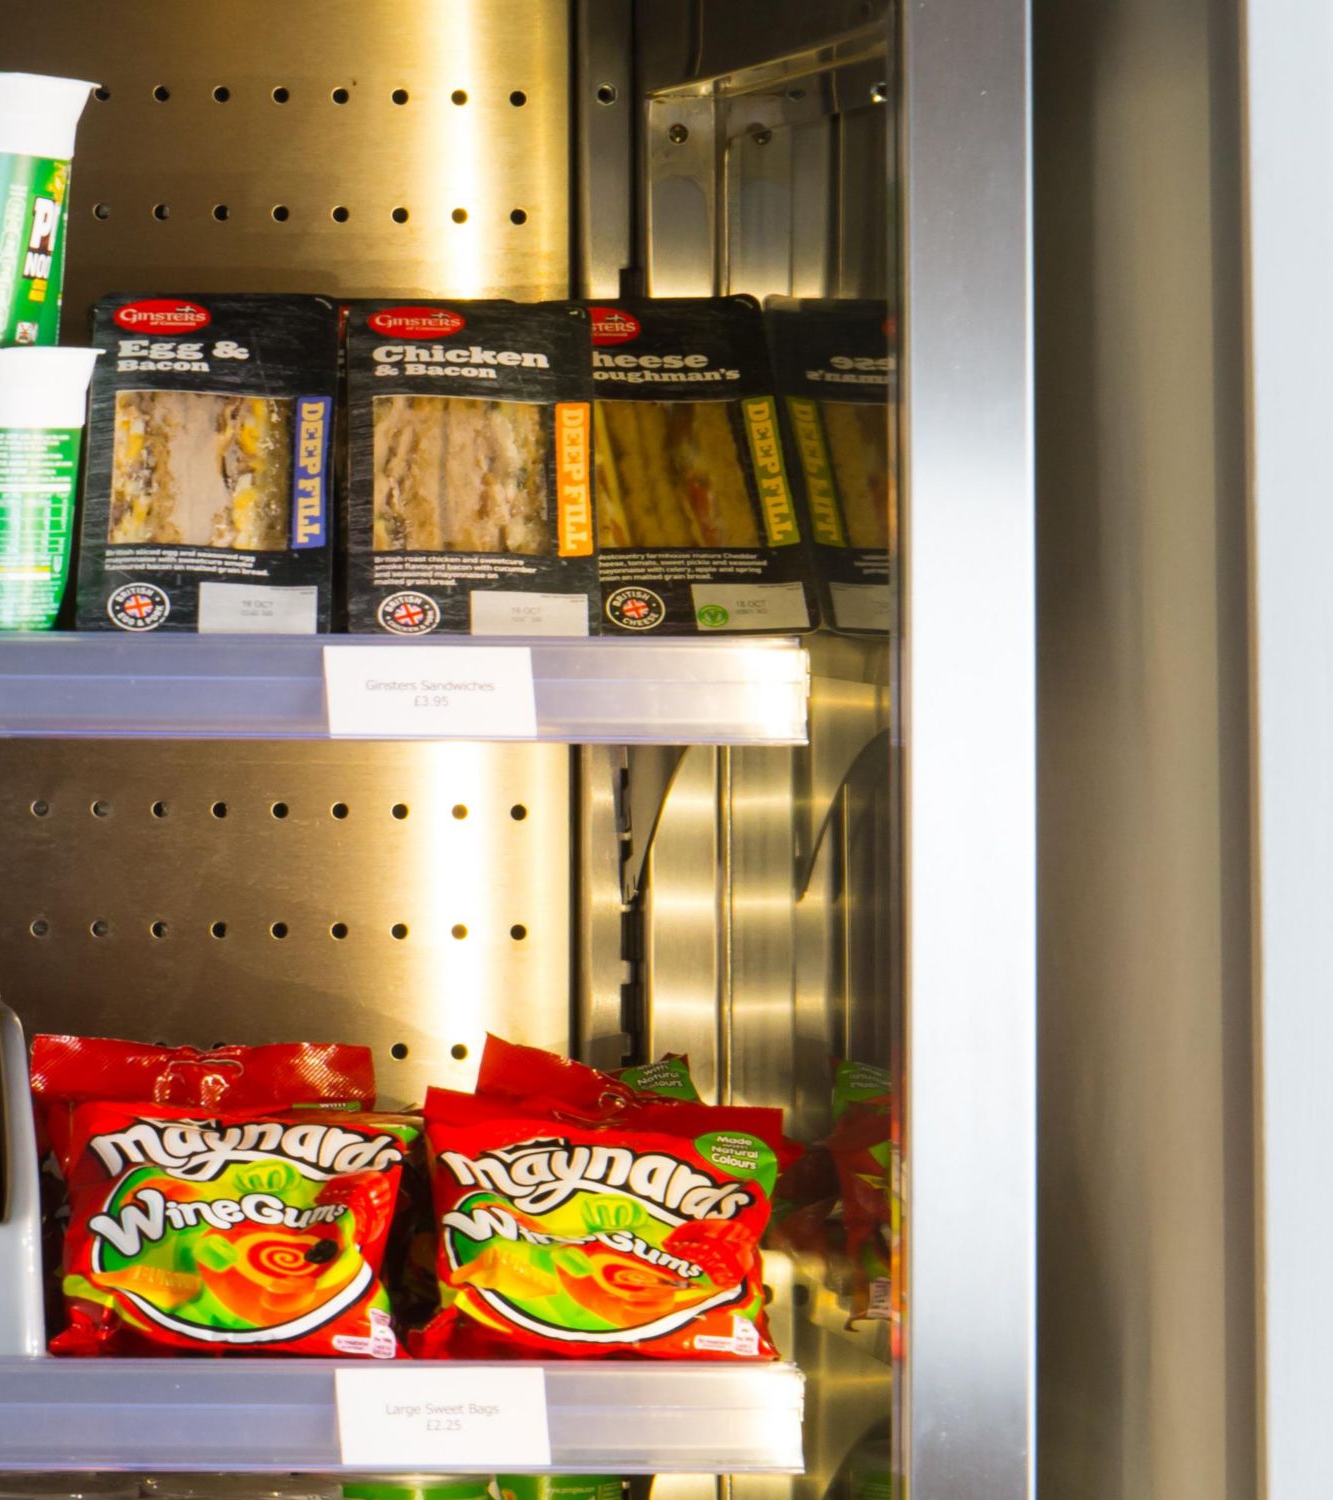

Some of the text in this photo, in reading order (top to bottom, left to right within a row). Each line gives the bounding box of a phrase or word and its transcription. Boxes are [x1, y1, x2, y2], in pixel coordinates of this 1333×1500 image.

[117, 339, 250, 361] Egg &
[373, 345, 550, 370] Chicken
[591, 350, 709, 370] heese
[117, 360, 210, 373] Bacon
[374, 363, 498, 380] & Bacon
[298, 402, 325, 474] DEEP
[562, 407, 587, 482] DEEP
[747, 401, 779, 475] DEEP
[296, 476, 321, 544] FILL
[761, 475, 794, 541] FILL
[564, 485, 588, 552] FILL
[365, 680, 496, 692] Ginsters Sandwiches
[717, 1134, 754, 1147] Made
[711, 1145, 760, 1160] Natural
[711, 1152, 758, 1171] Colours
[386, 1403, 500, 1418] Large Sweet Bags
[426, 1420, 462, 1432] £2.25
